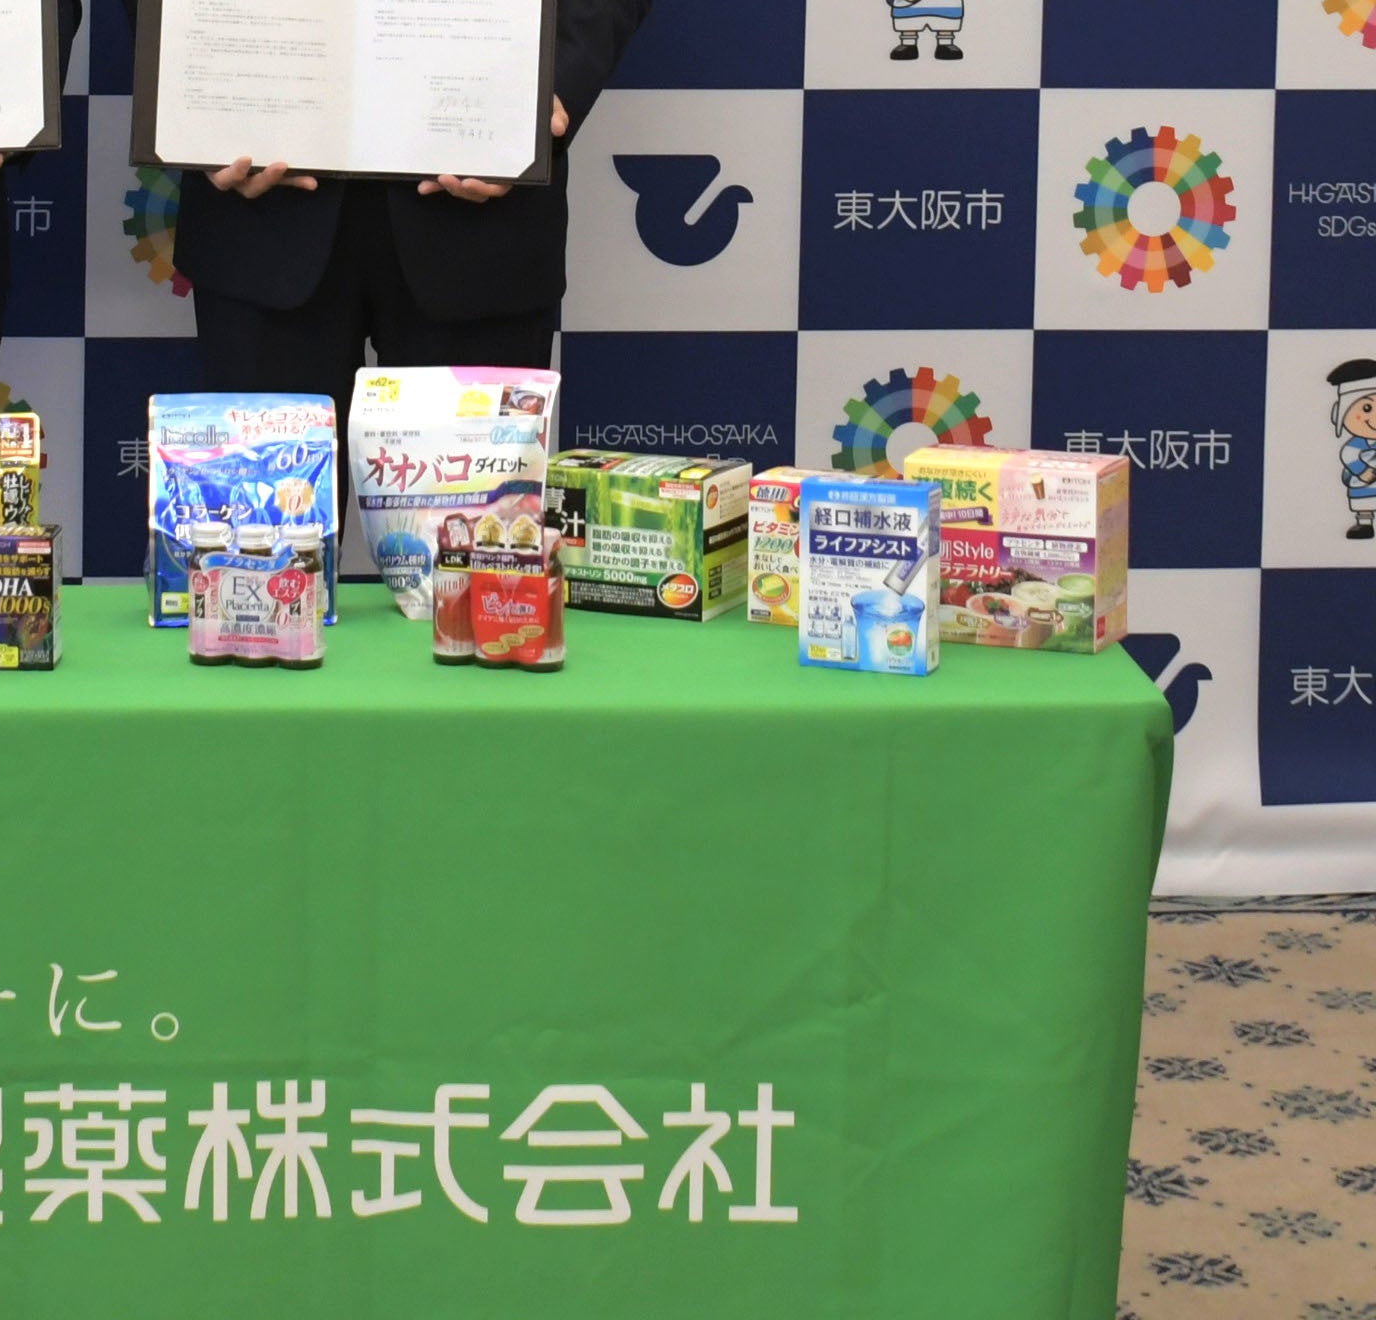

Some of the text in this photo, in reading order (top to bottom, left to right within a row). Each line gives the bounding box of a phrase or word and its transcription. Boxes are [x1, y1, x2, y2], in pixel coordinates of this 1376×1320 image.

[834, 189, 1004, 231] 東大阪市
[575, 424, 778, 446] HIGASHIOSAKA
[362, 446, 528, 493] オオバコ ダイエット
[175, 503, 252, 521] コラーゲン
[814, 507, 912, 532] 経口補水液
[592, 528, 673, 544] 脂肪の吸収を抑える
[753, 521, 800, 537] ビタミン
[814, 535, 911, 557] ライフアシスト
[953, 540, 995, 561] Style
[592, 555, 684, 571] おなかの調子を整える
[754, 563, 799, 574] おいしく食べ
[1290, 666, 1372, 706] 東大
